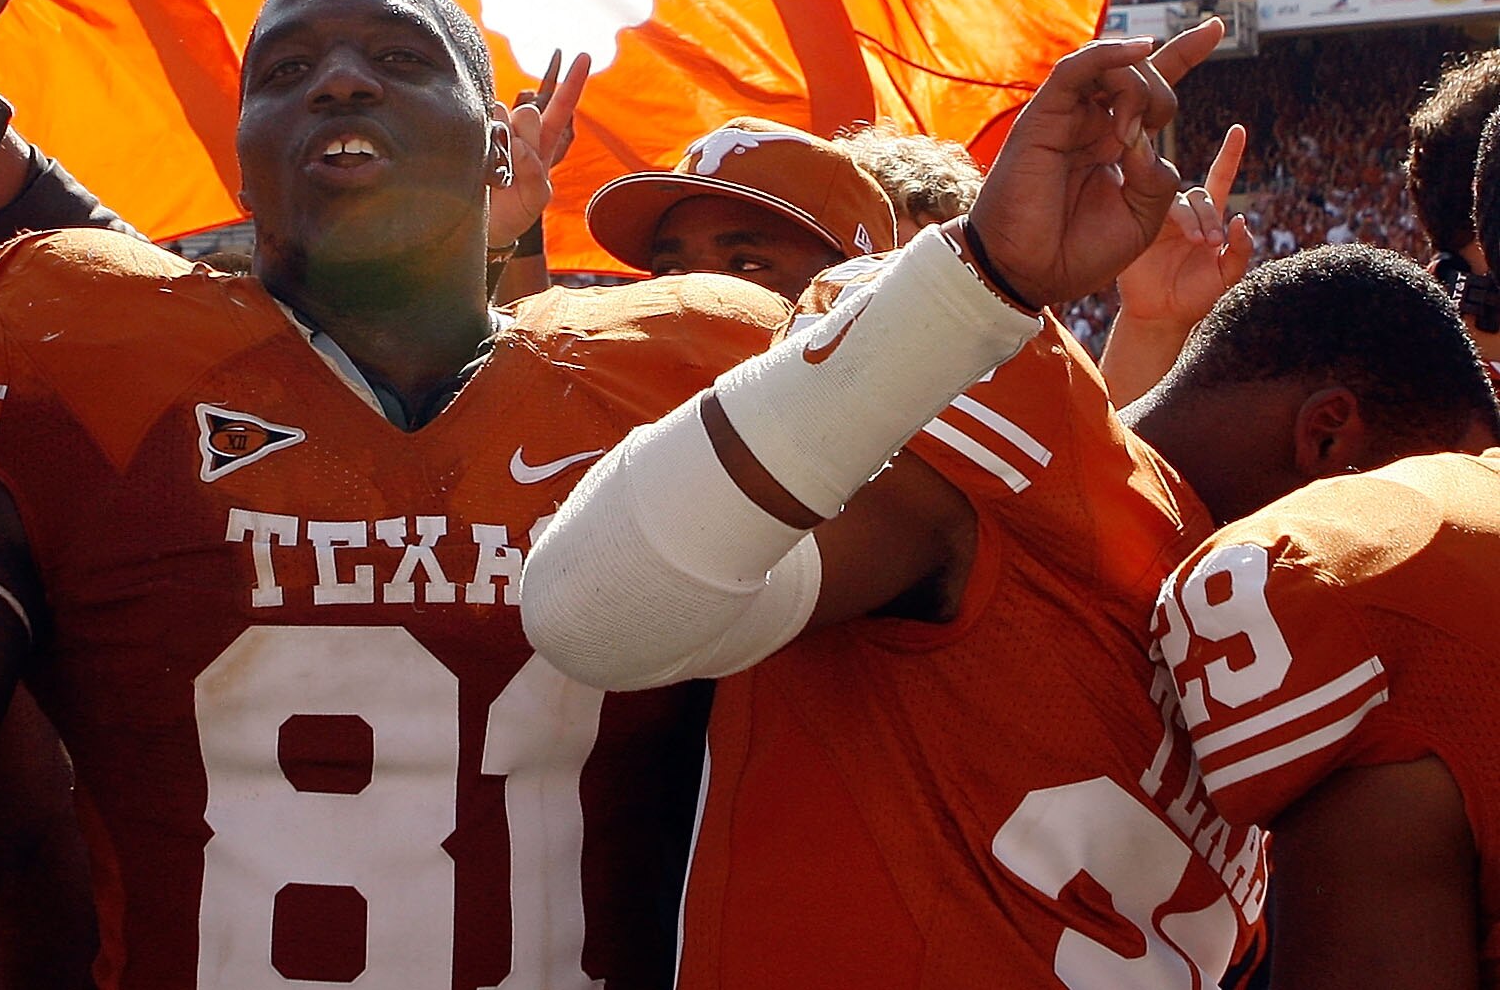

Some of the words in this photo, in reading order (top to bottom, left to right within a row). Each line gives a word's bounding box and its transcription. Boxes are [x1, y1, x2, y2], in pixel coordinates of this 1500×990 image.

[225, 508, 557, 607] TEXA
[194, 625, 607, 989] 81
[991, 774, 1239, 989] 3
